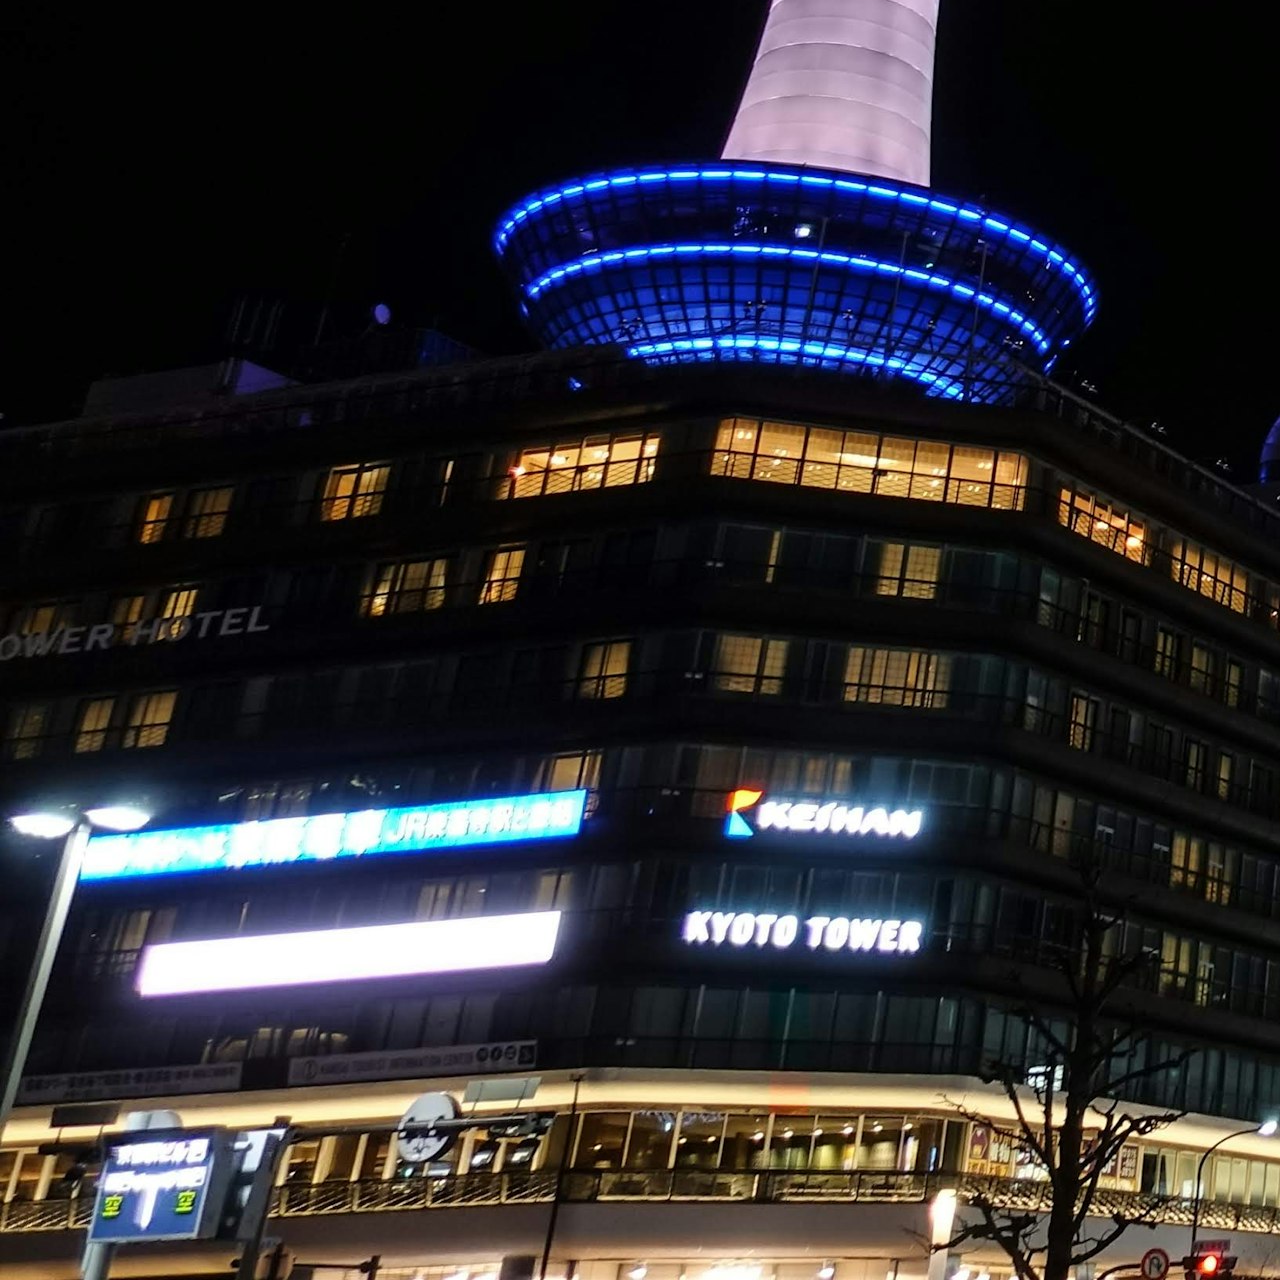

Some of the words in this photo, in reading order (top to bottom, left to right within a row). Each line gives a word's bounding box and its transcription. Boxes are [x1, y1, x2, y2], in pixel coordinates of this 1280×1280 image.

[130, 606, 270, 646] HOTEL
[757, 801, 922, 839] KEIHAN
[686, 911, 798, 948] KYOTO
[806, 917, 922, 955] TOWER
